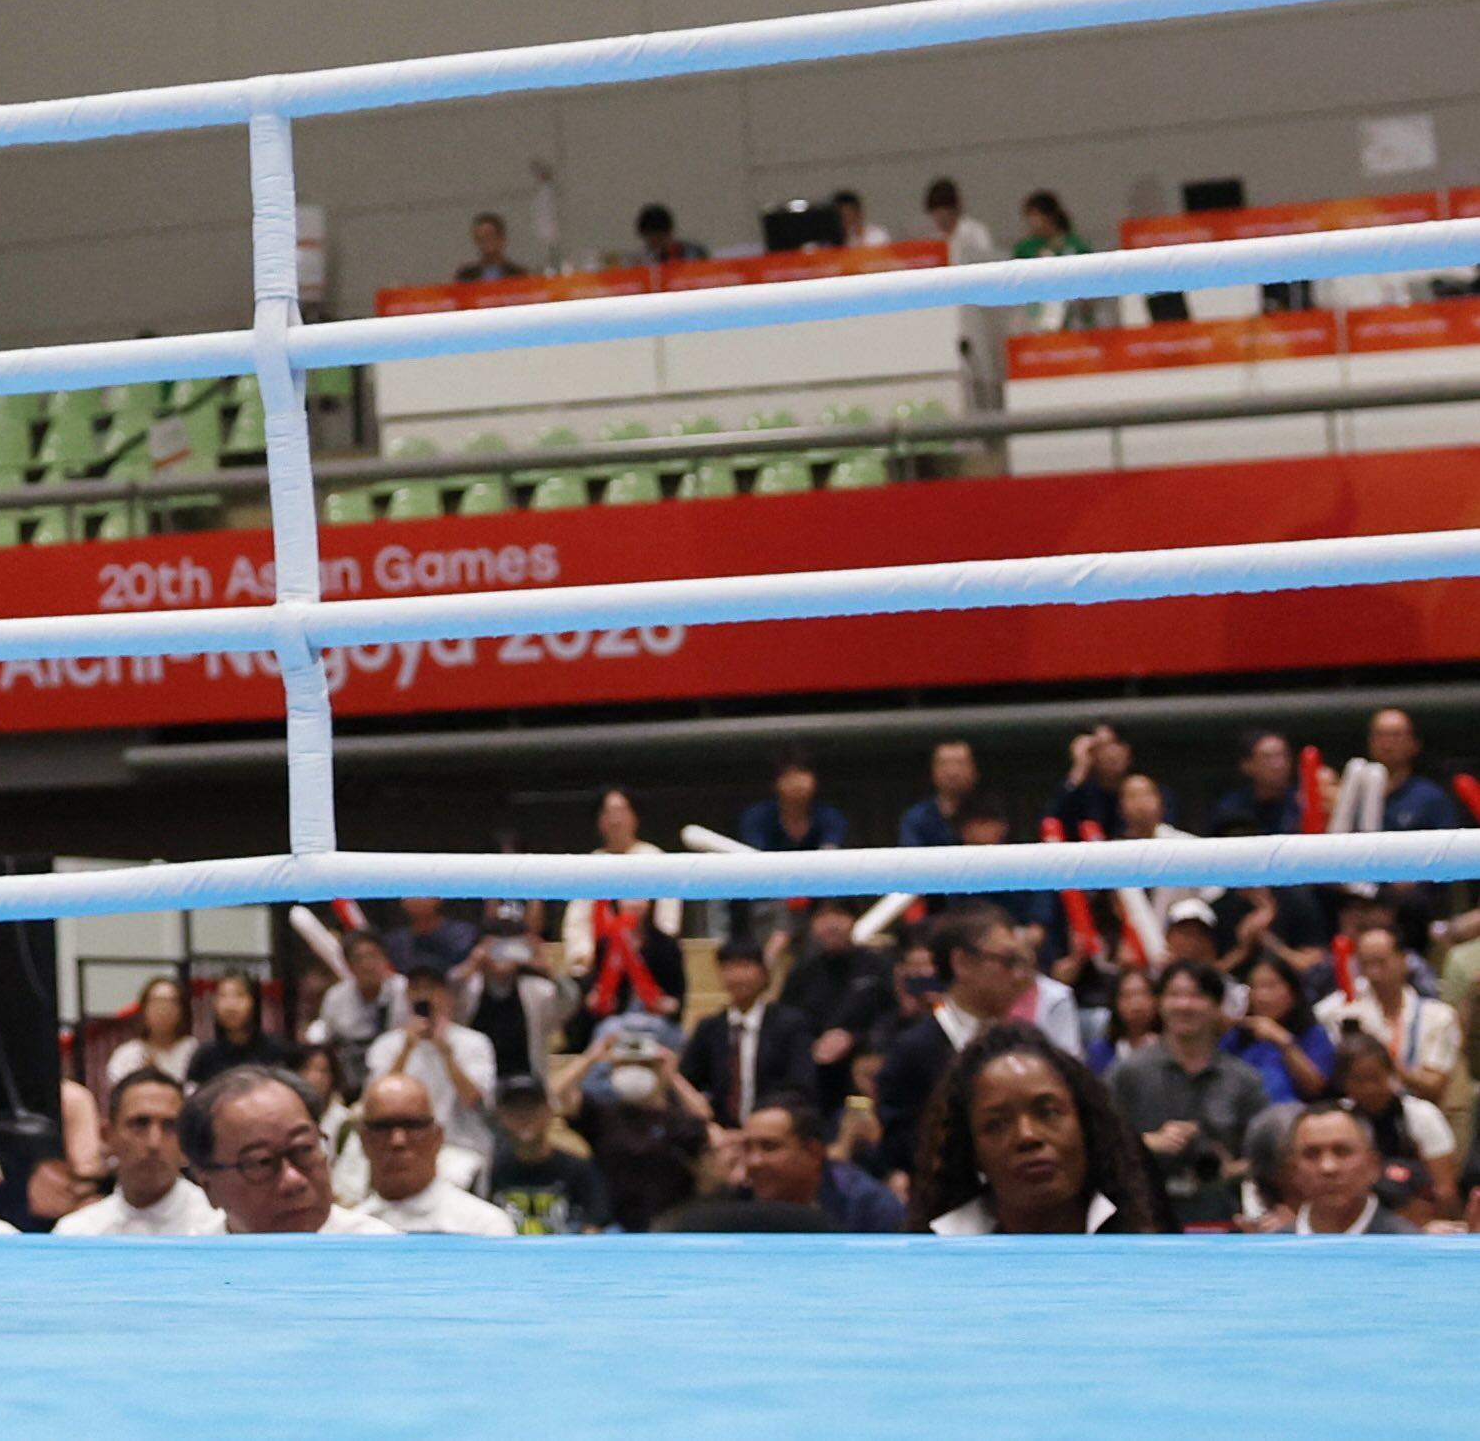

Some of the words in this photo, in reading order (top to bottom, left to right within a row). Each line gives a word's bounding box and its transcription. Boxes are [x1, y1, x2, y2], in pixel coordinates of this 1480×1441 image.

[97, 556, 213, 609] 20th
[225, 554, 362, 601] Asn
[373, 542, 561, 593] Games
